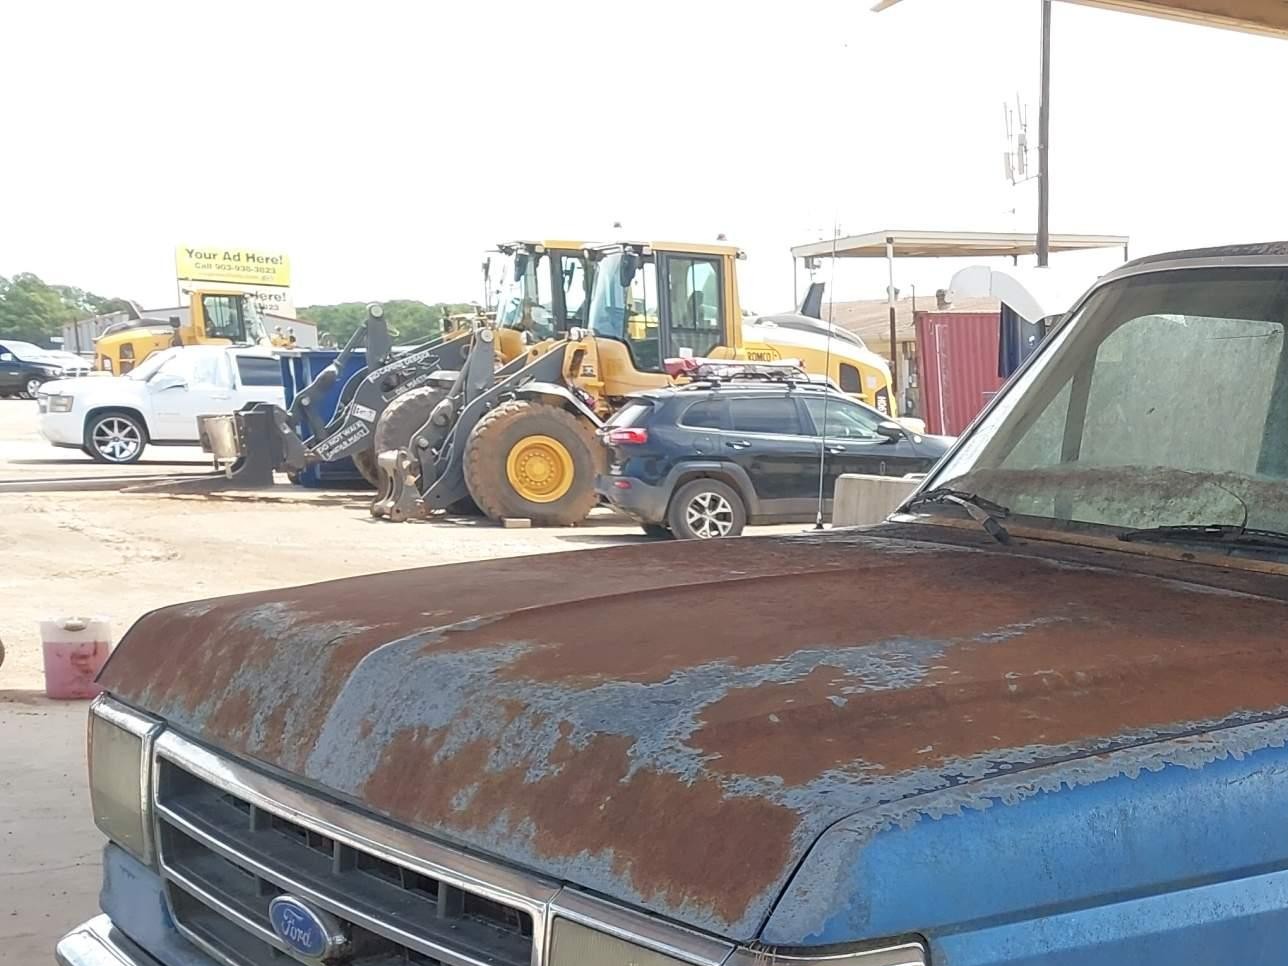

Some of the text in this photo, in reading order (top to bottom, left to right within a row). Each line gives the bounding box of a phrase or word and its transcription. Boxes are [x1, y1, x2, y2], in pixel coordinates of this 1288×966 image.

[185, 248, 283, 265] Your Ad Here!
[194, 262, 212, 270] Call
[281, 908, 313, 948] Ford
